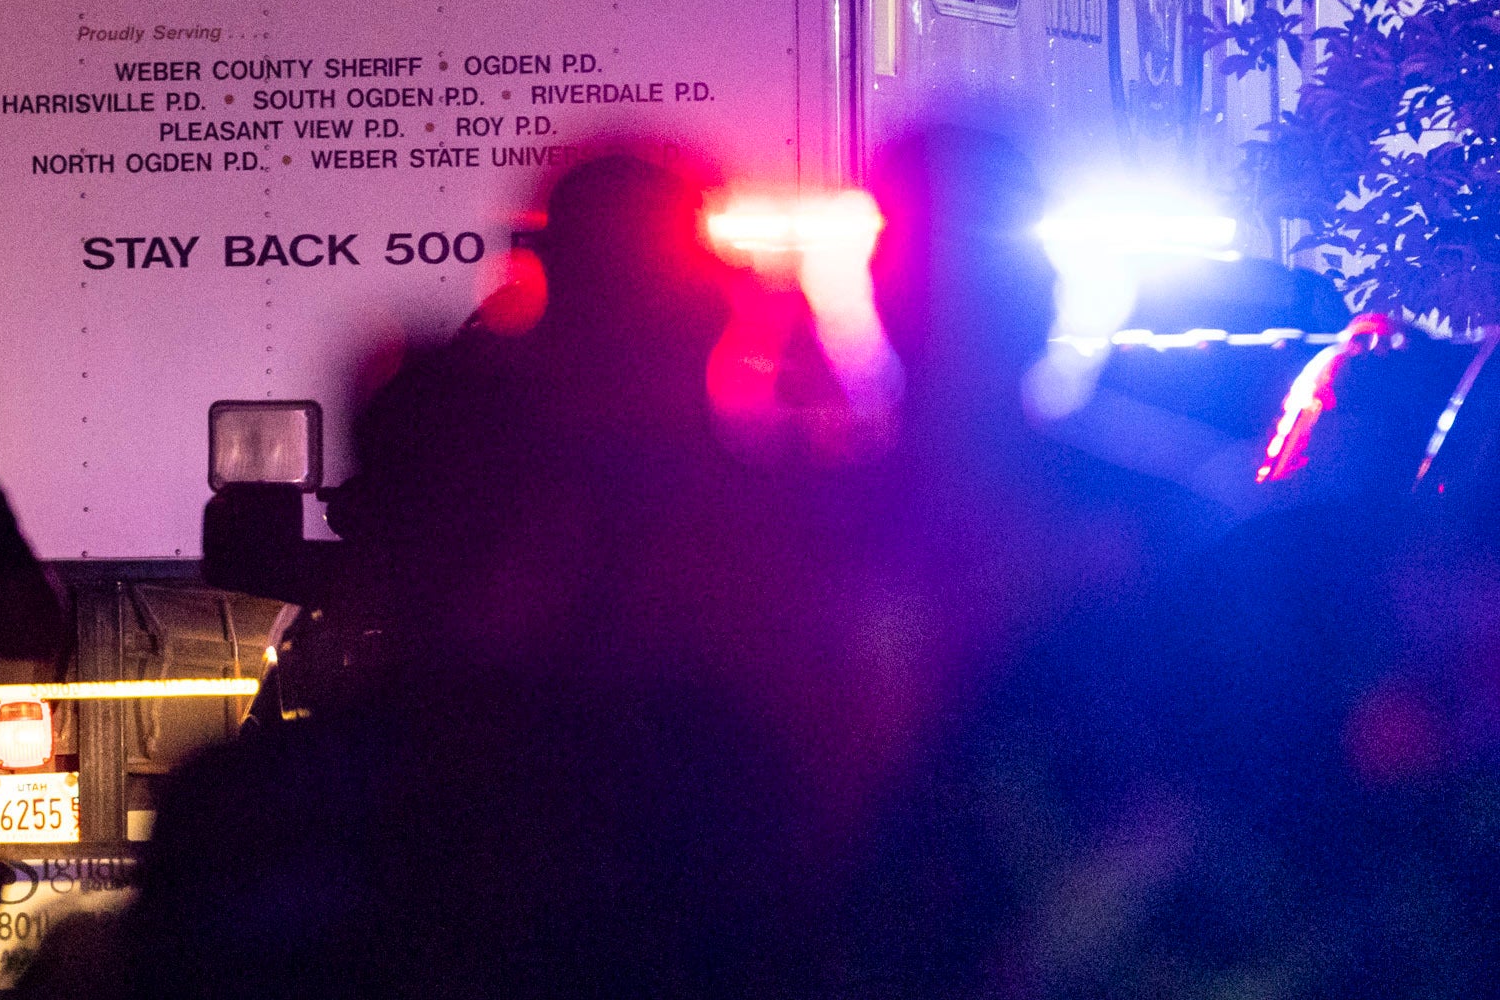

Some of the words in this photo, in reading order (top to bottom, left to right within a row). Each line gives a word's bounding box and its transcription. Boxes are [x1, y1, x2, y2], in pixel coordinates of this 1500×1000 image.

[77, 25, 145, 43] Proudly
[114, 61, 201, 82] WEBER
[212, 58, 314, 81] COUNTY
[324, 56, 423, 79] SHERIFF
[464, 54, 551, 76] OGDEN
[562, 53, 603, 74] P.D.
[2, 92, 155, 114] HARRISVILLE
[166, 91, 207, 112] P.D.
[253, 89, 336, 111] SOUTH
[346, 87, 434, 109] OGDEN
[444, 86, 485, 107] P.D.
[531, 83, 664, 105] RIVERDALE
[675, 82, 715, 102] P.D.
[159, 120, 284, 142] PLEASANT
[293, 119, 354, 139] VIEW
[364, 118, 405, 139] P.D.
[456, 116, 504, 137] ROY
[515, 115, 557, 136] P.D.
[32, 153, 115, 175] NORTH
[125, 152, 213, 174] OGDEN
[223, 151, 265, 172] P.D.
[311, 149, 398, 170] WEBER
[409, 147, 480, 168] STATE
[82, 235, 200, 271] STAY
[224, 233, 361, 268] BACK
[384, 231, 486, 266] 500
[18, 783, 48, 792] UTAH
